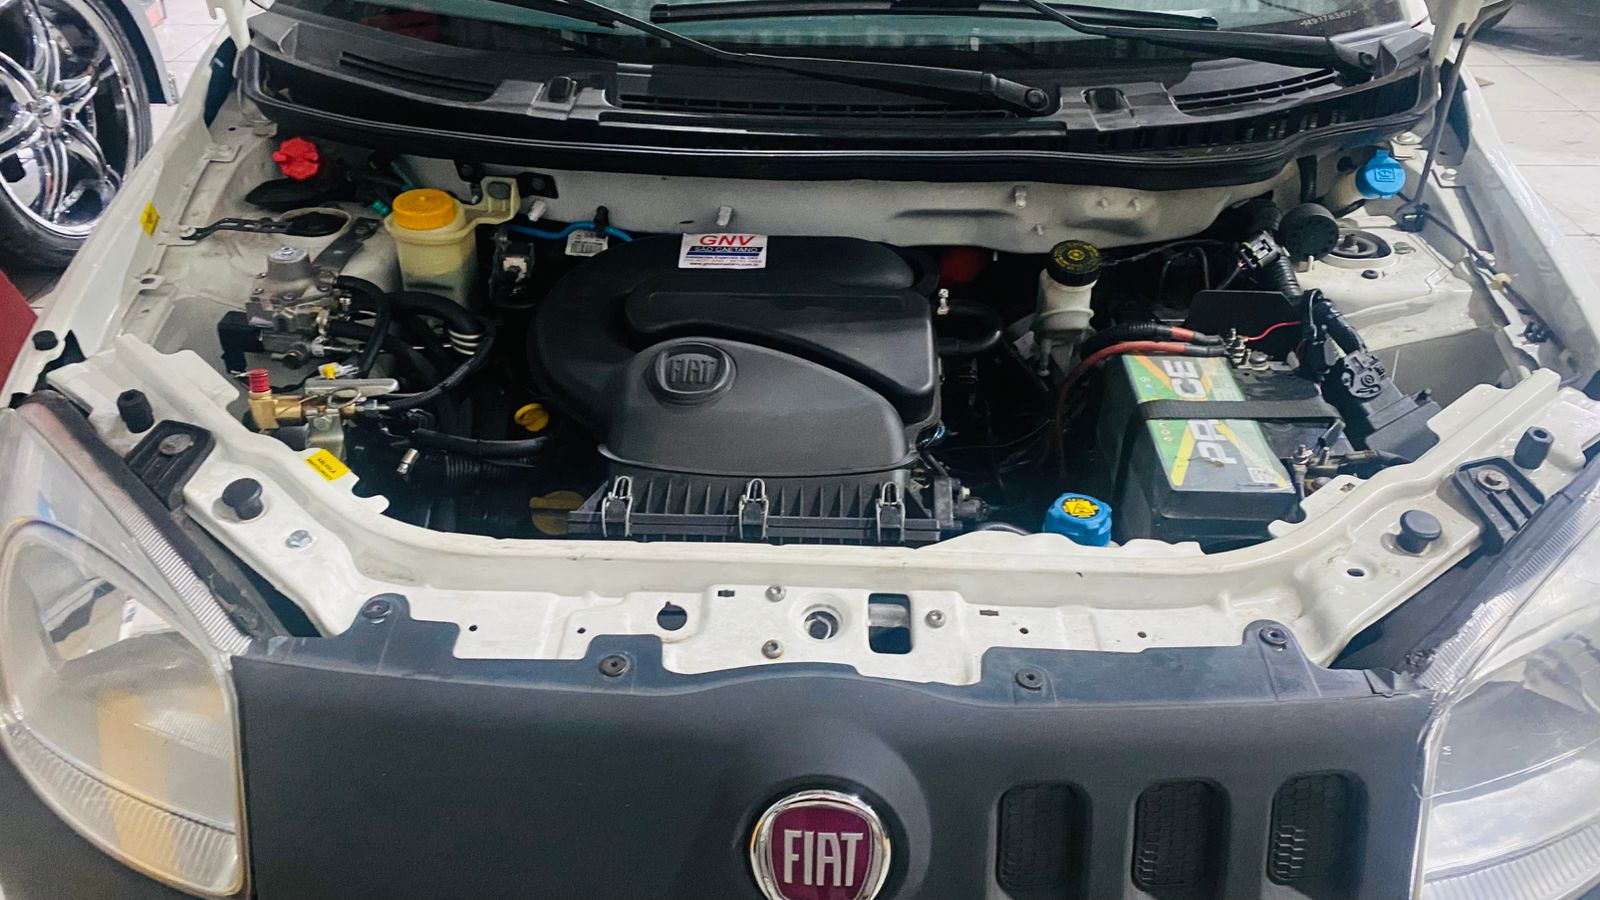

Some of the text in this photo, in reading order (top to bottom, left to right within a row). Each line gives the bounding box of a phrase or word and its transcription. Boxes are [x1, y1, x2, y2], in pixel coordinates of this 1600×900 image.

[700, 235, 756, 246] GNV
[669, 358, 717, 385] FIAT
[784, 829, 864, 887] FIAT
